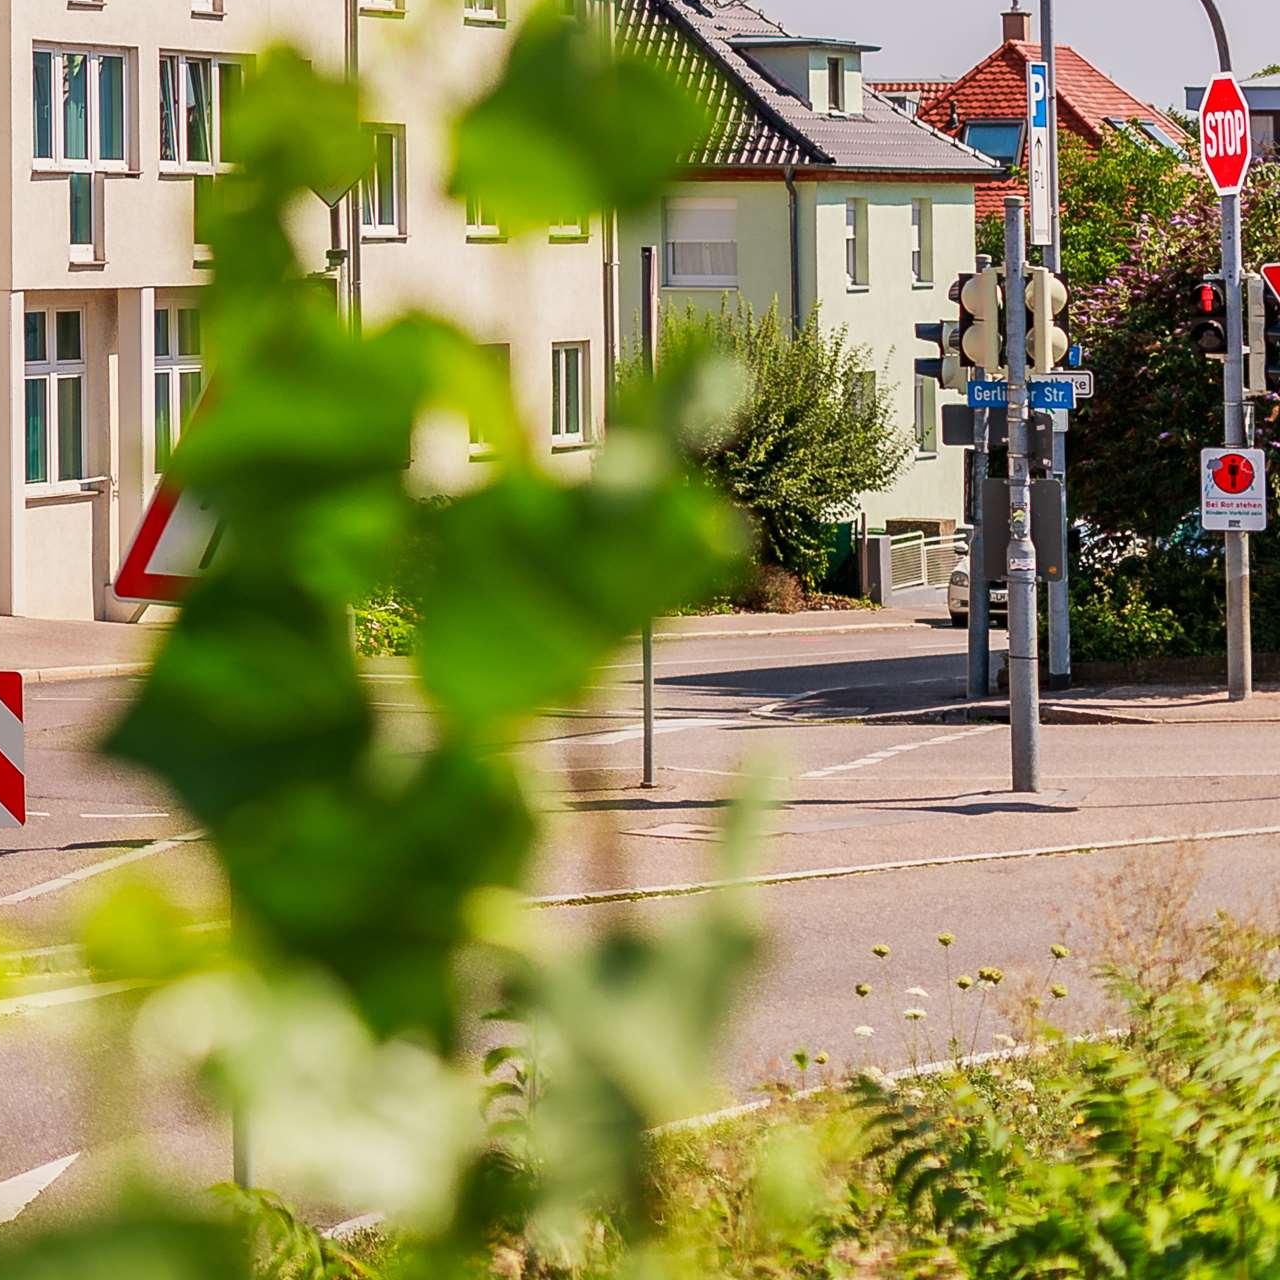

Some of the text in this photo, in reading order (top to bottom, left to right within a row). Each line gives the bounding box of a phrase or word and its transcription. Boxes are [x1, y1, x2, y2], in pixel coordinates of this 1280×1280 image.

[1205, 109, 1245, 158] STOP
[974, 385, 1068, 403] Gerlir Str.
